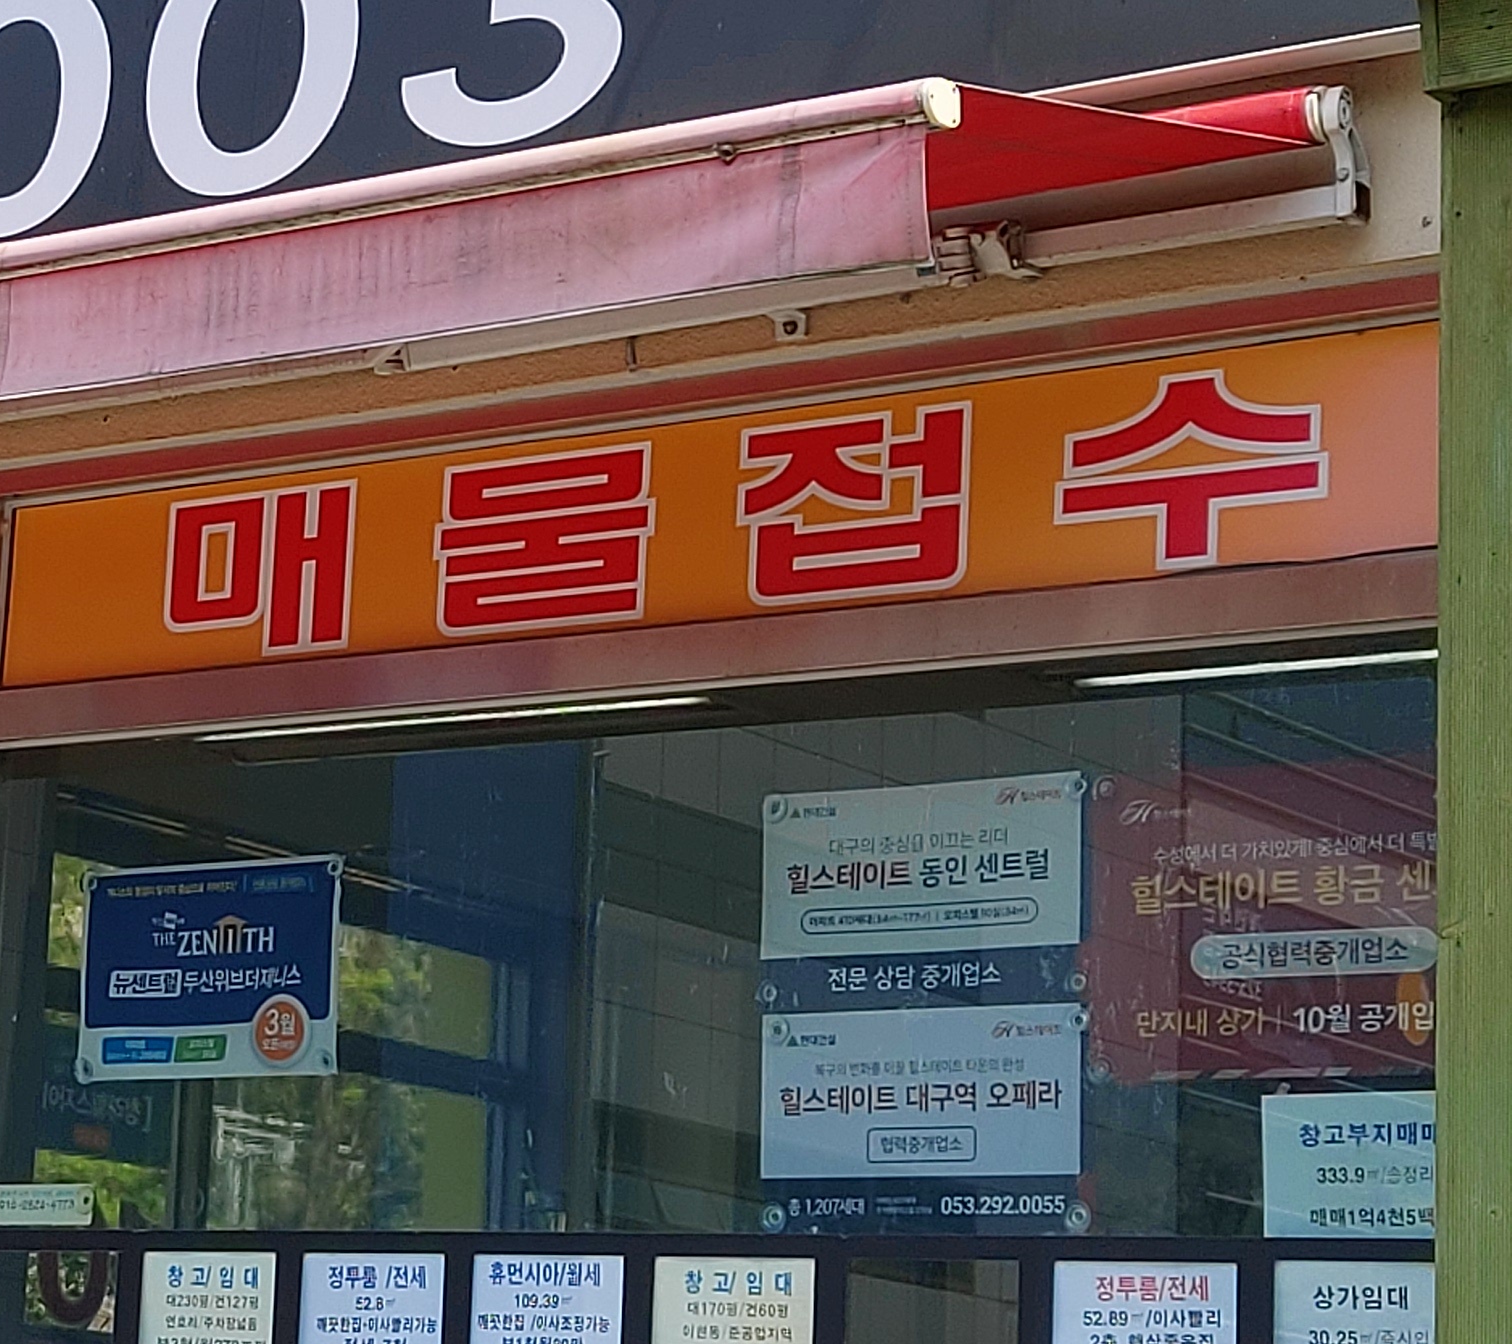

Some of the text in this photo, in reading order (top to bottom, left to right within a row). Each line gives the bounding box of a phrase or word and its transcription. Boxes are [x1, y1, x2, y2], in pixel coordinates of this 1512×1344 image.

[977, 827, 1009, 847] 리더
[786, 847, 1050, 896] 힐스테이트 동인 센트럴
[1313, 863, 1386, 907] 황금
[1396, 859, 1436, 903] 센
[151, 925, 275, 958] THE ZENITH
[1220, 936, 1410, 970] 공식협력중개업소
[827, 962, 1002, 994] 전문 상담 중개업소
[263, 1008, 296, 1037] 3월
[1137, 1008, 1209, 1038] 단지내
[1216, 1007, 1264, 1036] 상가
[1292, 1003, 1353, 1035] 10월
[779, 1078, 1063, 1117] 힐스테이트 대구역 오페라
[939, 1195, 1066, 1215] 053.292.0055
[1095, 1273, 1210, 1303] 정투룸/전세
[1312, 1284, 1410, 1311] 상가임대
